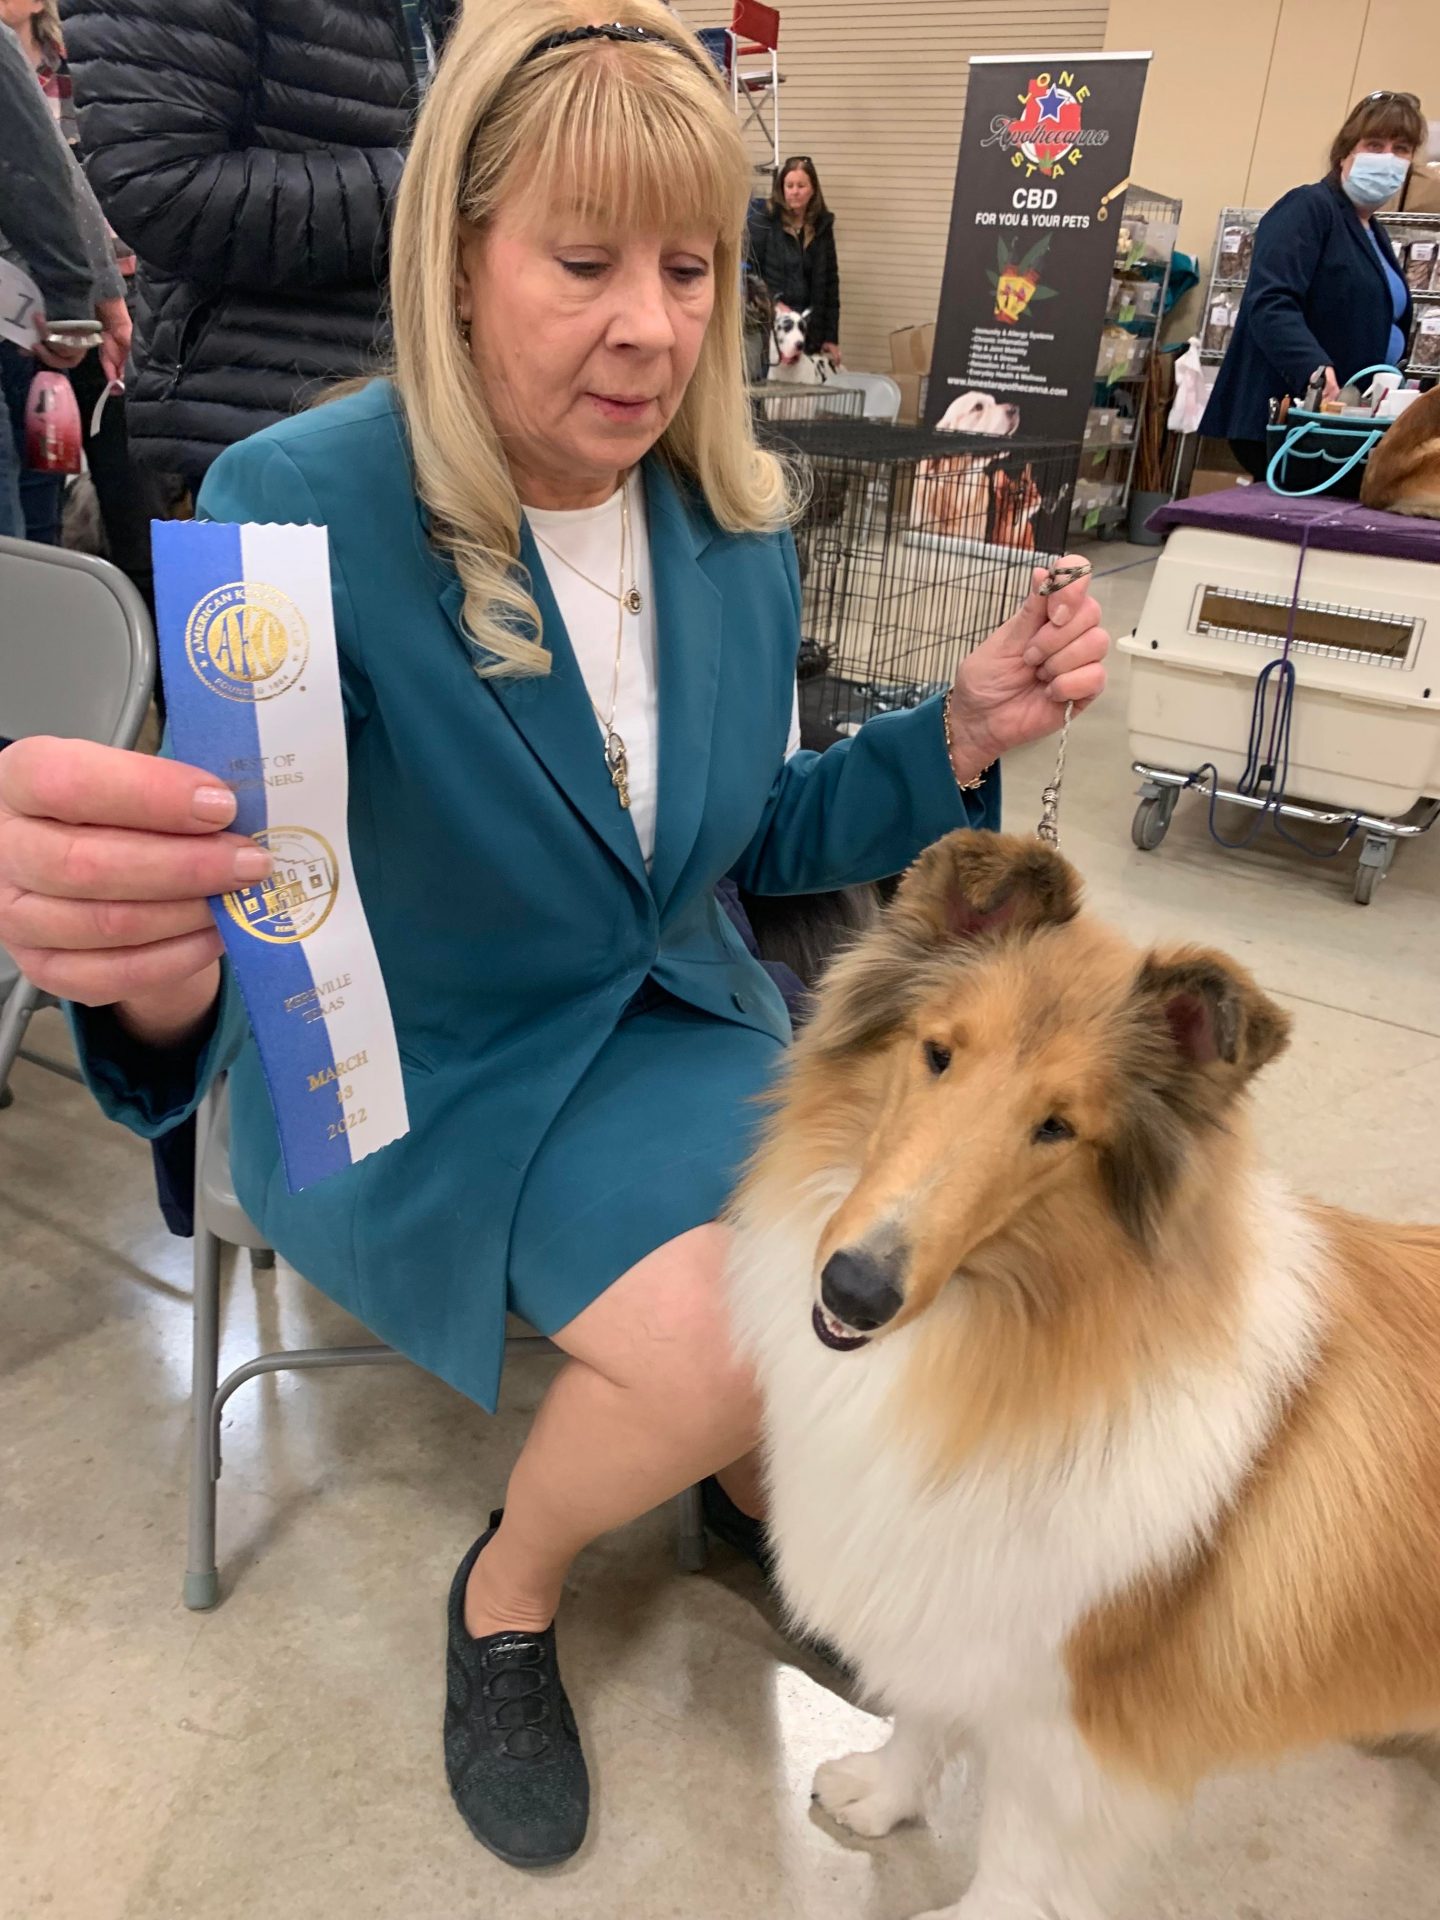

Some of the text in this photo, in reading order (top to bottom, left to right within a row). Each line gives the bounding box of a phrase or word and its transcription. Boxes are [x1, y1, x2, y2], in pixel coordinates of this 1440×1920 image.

[1018, 71, 1091, 104] LONE
[1011, 148, 1083, 179] STAR
[1012, 188, 1058, 209] CBD
[975, 212, 1090, 228] FOR YOU & YOUR PETS
[947, 376, 1068, 397] www.lonestarapothecanna.com
[193, 591, 233, 654] AMERICAN
[215, 606, 281, 678] AKC
[273, 753, 296, 768] OF
[306, 1050, 369, 1092] MARCH
[327, 1108, 368, 1141] 2022
